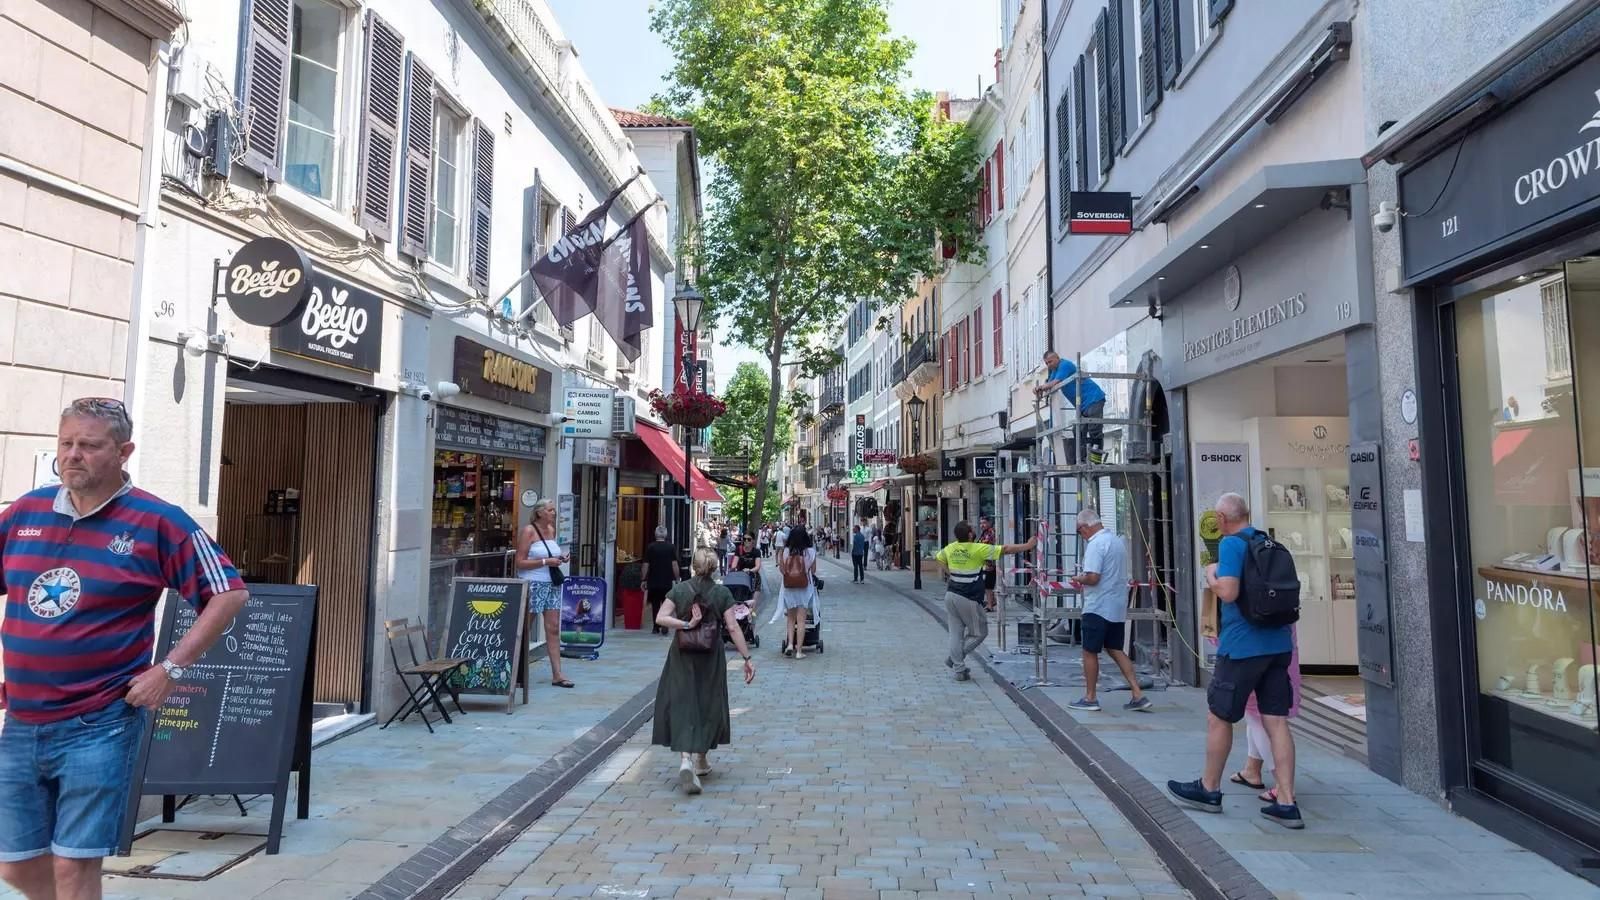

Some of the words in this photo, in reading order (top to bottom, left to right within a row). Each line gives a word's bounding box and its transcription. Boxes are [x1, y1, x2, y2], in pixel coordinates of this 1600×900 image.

[1441, 216, 1458, 238] 121
[231, 263, 300, 298] Beeyo
[161, 300, 175, 317] 96
[301, 286, 367, 348] Beeyo
[1334, 302, 1351, 321] 119
[308, 342, 325, 353] NATURAL
[325, 346, 340, 357] FROZEN
[483, 349, 538, 394] RAMSONS
[857, 425, 865, 461] CARLOS
[1288, 441, 1345, 454] NOMINATIO
[1351, 452, 1375, 462] CASIO
[1354, 502, 1378, 511] EDIFICE
[17, 528, 42, 536] adidas
[467, 584, 508, 593] RAMSONS
[29, 595, 55, 617] BROWN
[60, 598, 77, 613] ALE
[468, 613, 502, 631] here
[451, 643, 480, 660] the
[182, 669, 215, 681] oothies
[162, 707, 188, 717] banana
[159, 717, 199, 731] pineapple
